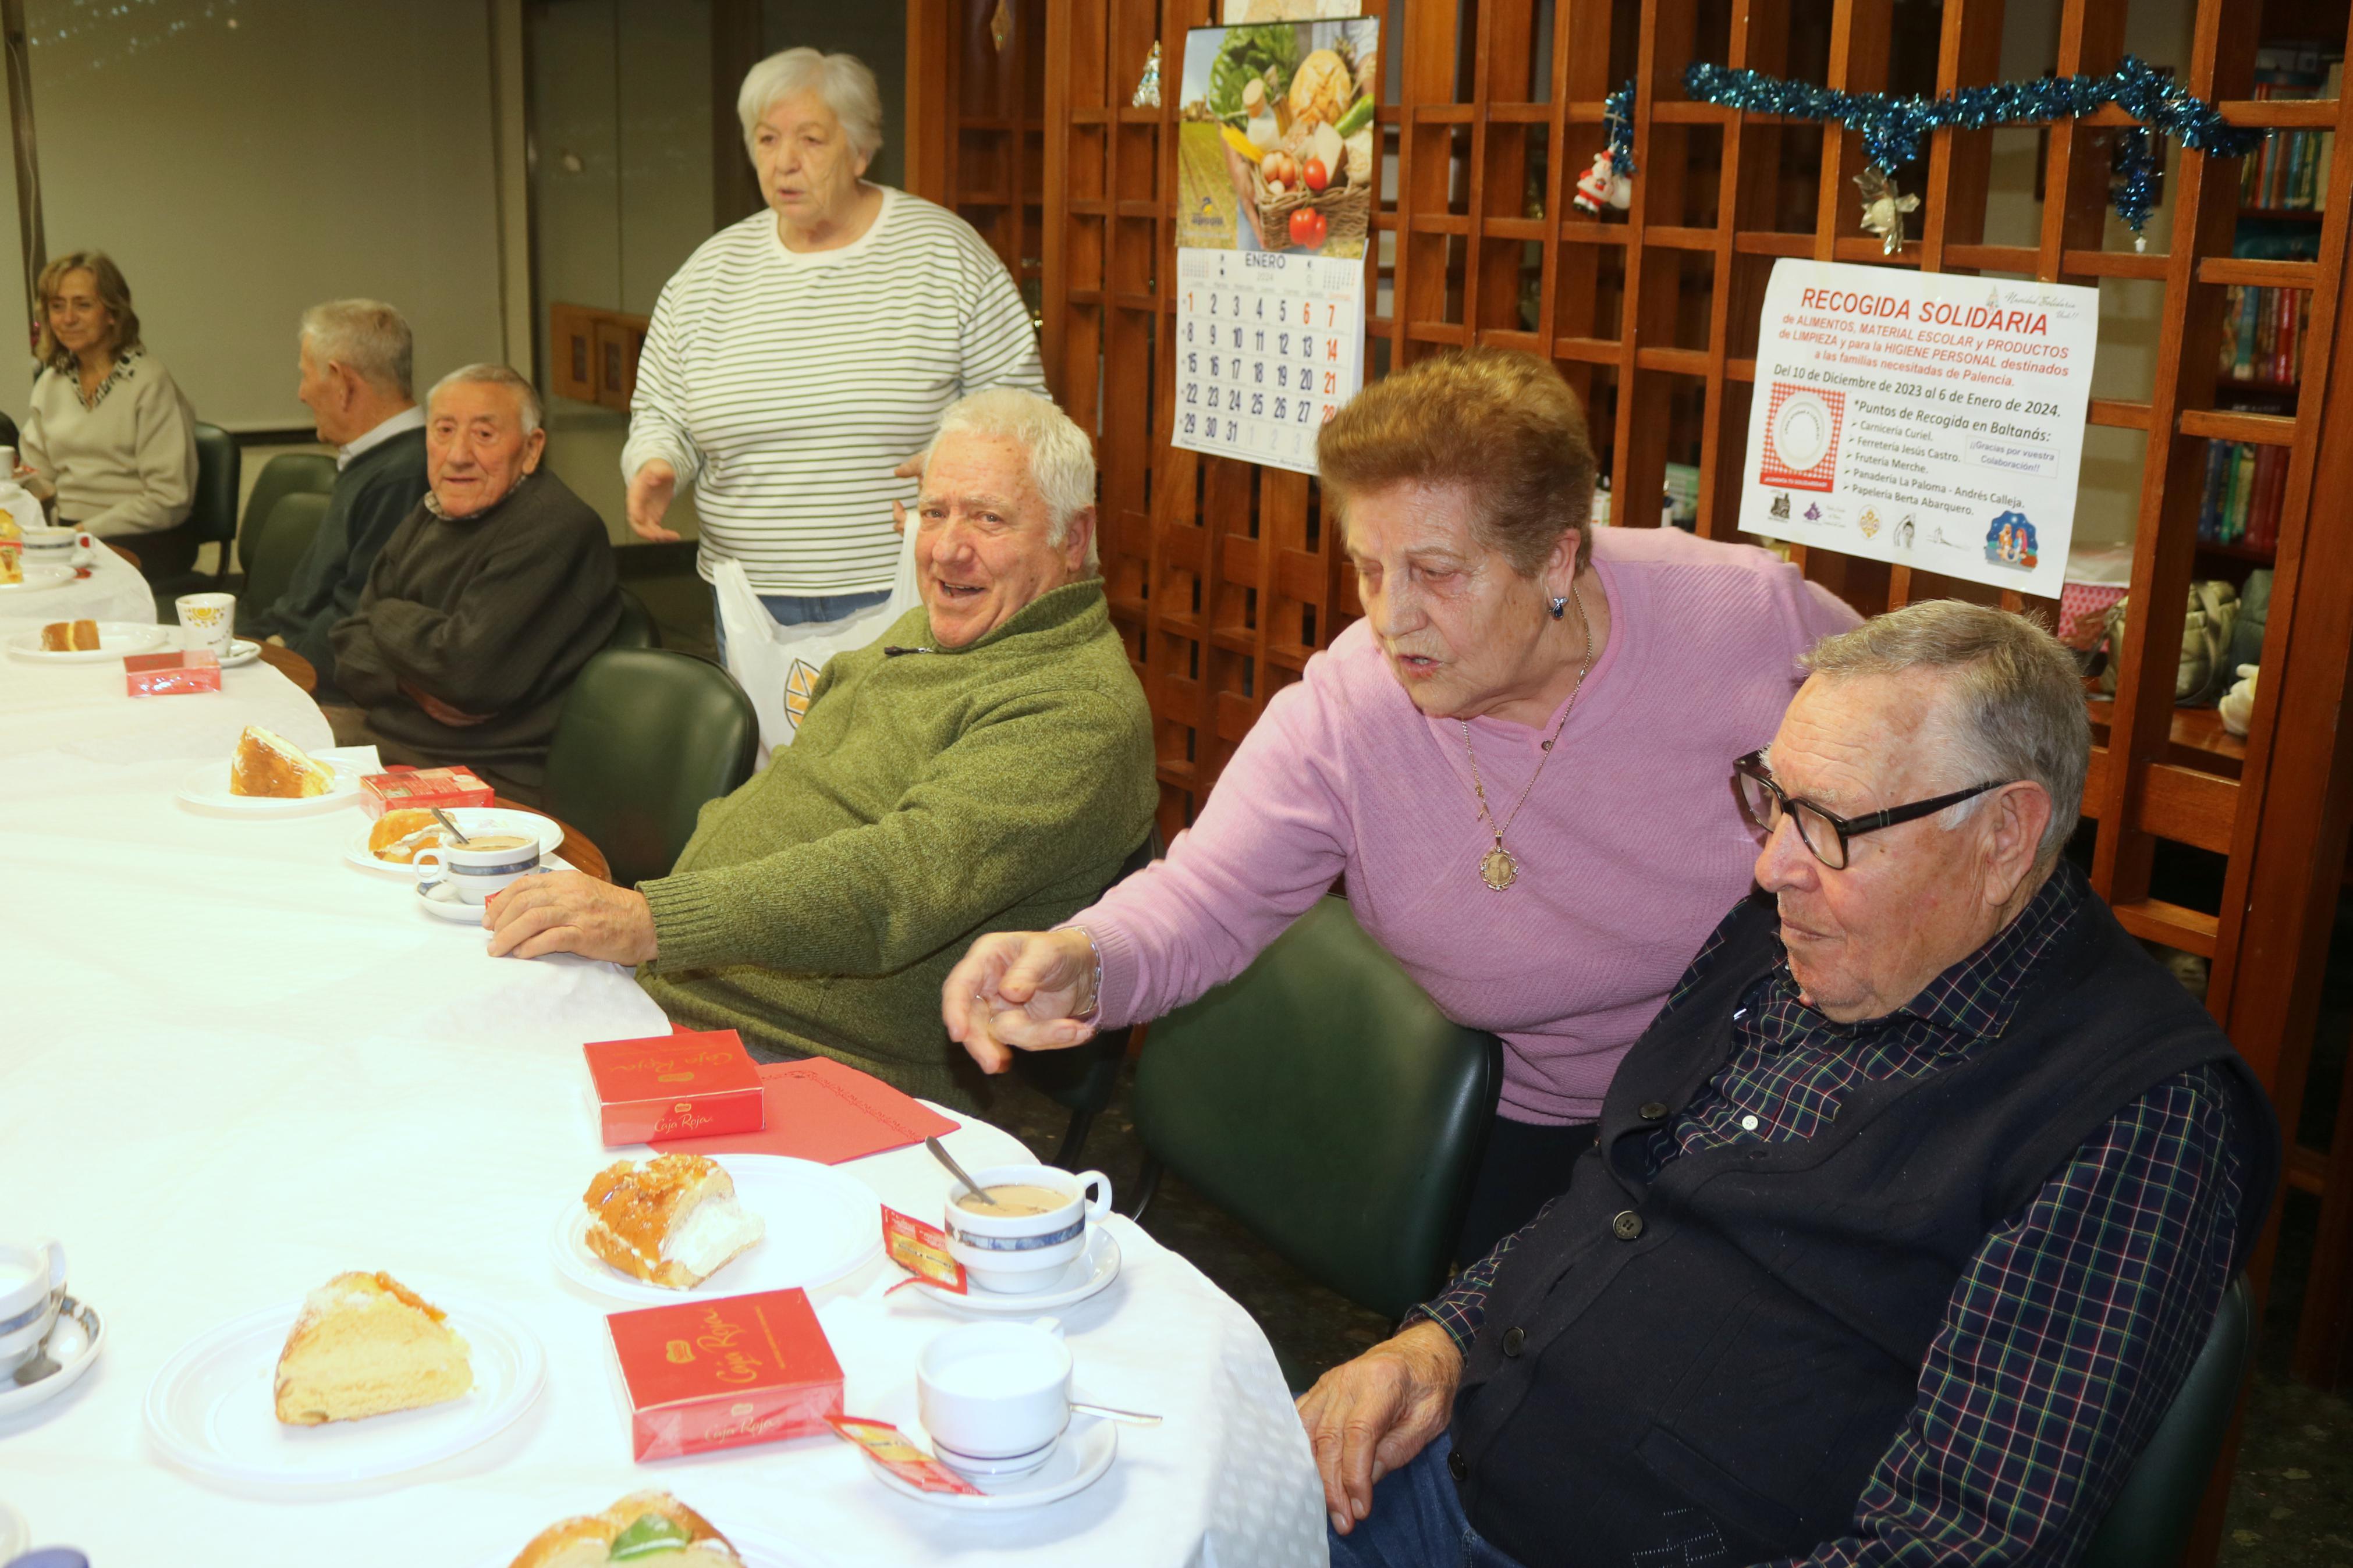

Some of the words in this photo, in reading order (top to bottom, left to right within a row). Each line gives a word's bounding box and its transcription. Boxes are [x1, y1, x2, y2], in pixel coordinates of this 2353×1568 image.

[1245, 253, 1286, 269] ENERO
[1187, 291, 1193, 312] 1
[1211, 293, 1217, 314] 2
[1233, 296, 1240, 317] 3
[1256, 297, 1263, 319] 4
[1279, 300, 1286, 321] 5
[1304, 302, 1310, 325] 6
[1328, 304, 1335, 327] 7
[1801, 288, 1910, 320] RECOGIDA
[1919, 301, 2047, 336] SOLIDARIA
[1187, 322, 1194, 342] 8
[1210, 324, 1216, 345] 9
[1233, 328, 1242, 349] 10
[1256, 329, 1264, 351] 11
[1279, 333, 1289, 355] 12
[1303, 336, 1312, 357] 13
[1326, 338, 1337, 361] 14
[1779, 329, 1790, 339] de
[1793, 330, 1837, 346] LIMPIEZA
[1840, 339, 1846, 349] y
[1848, 340, 1871, 350] para
[1872, 341, 1882, 351] la
[1884, 343, 1930, 358] HIGIENE
[1932, 349, 1997, 367] PERSONAL
[2001, 358, 2070, 376] destinados
[1783, 314, 1794, 323] de
[1797, 315, 1856, 333] ALIMENTOS,
[1859, 323, 1914, 340] MATERIAL
[1918, 330, 1974, 347] ESCOLAR
[1976, 340, 1983, 351] y
[1986, 339, 2070, 358] PRODUCTOS
[1188, 353, 1197, 373] 15
[1210, 356, 1219, 376] 16
[1232, 358, 1241, 379] 17
[1254, 362, 1263, 383] 18
[1277, 365, 1287, 386] 19
[1300, 368, 1312, 390] 20
[1324, 372, 1336, 394] 21
[1815, 351, 1820, 359] a
[1823, 350, 1837, 361] las
[1839, 353, 1878, 368] familias
[1880, 360, 1943, 378] necesitadas
[1946, 368, 1960, 379] de
[1962, 369, 2015, 387] Palencia.
[1186, 383, 1198, 404] 22
[1208, 386, 1219, 407] 23
[1230, 389, 1241, 411] 24
[1252, 393, 1263, 415] 25
[1275, 397, 1286, 419] 26
[1298, 401, 1310, 423] 27
[1773, 364, 1791, 376] Del
[1793, 367, 1805, 379] 10
[1807, 369, 1820, 381] de
[1823, 371, 1876, 390] Diciembre
[1879, 380, 1891, 393] de
[1894, 382, 1922, 397] 2023
[1925, 387, 1936, 399] al
[1939, 389, 1946, 400] 6
[1950, 390, 1964, 403] de
[1967, 393, 2002, 409] Enero
[2006, 398, 2021, 411] de
[2024, 401, 2061, 418] 2024.
[1184, 413, 1195, 433] 29
[1205, 417, 1216, 438] 30
[1227, 421, 1237, 442] 31
[1860, 421, 1903, 436] Carnicería
[1905, 428, 1933, 442] Curiel.
[1899, 408, 1913, 420] de
[1915, 410, 1969, 429] Recogida
[1972, 421, 1988, 432] en
[1990, 422, 2052, 442] Baltanás:
[1855, 452, 1889, 467] Frutería
[1891, 459, 1929, 474] Merche.
[1857, 436, 1900, 452] Ferretería
[1901, 445, 1925, 457] Jesús
[1928, 448, 1961, 463] Castro.
[1981, 455, 2040, 472] Colaboración!!
[2006, 447, 2021, 456] por
[2023, 451, 2054, 461] vuestra
[1852, 484, 1892, 500] Papelería
[1895, 492, 1919, 505] Berta
[1921, 498, 1974, 515] Abarquero.
[1853, 468, 1897, 484] Panadería
[1899, 477, 1909, 487] La
[1911, 479, 1946, 493] Paloma
[1954, 486, 1988, 501] Andrés
[1990, 493, 2025, 509] Calleja.
[654, 1118, 677, 1134] Caja
[680, 1114, 713, 1130] Roja
[696, 1307, 746, 1354] Roja
[716, 1352, 764, 1384] Caja
[704, 1424, 736, 1444] Caja
[740, 1416, 774, 1437] Roja
